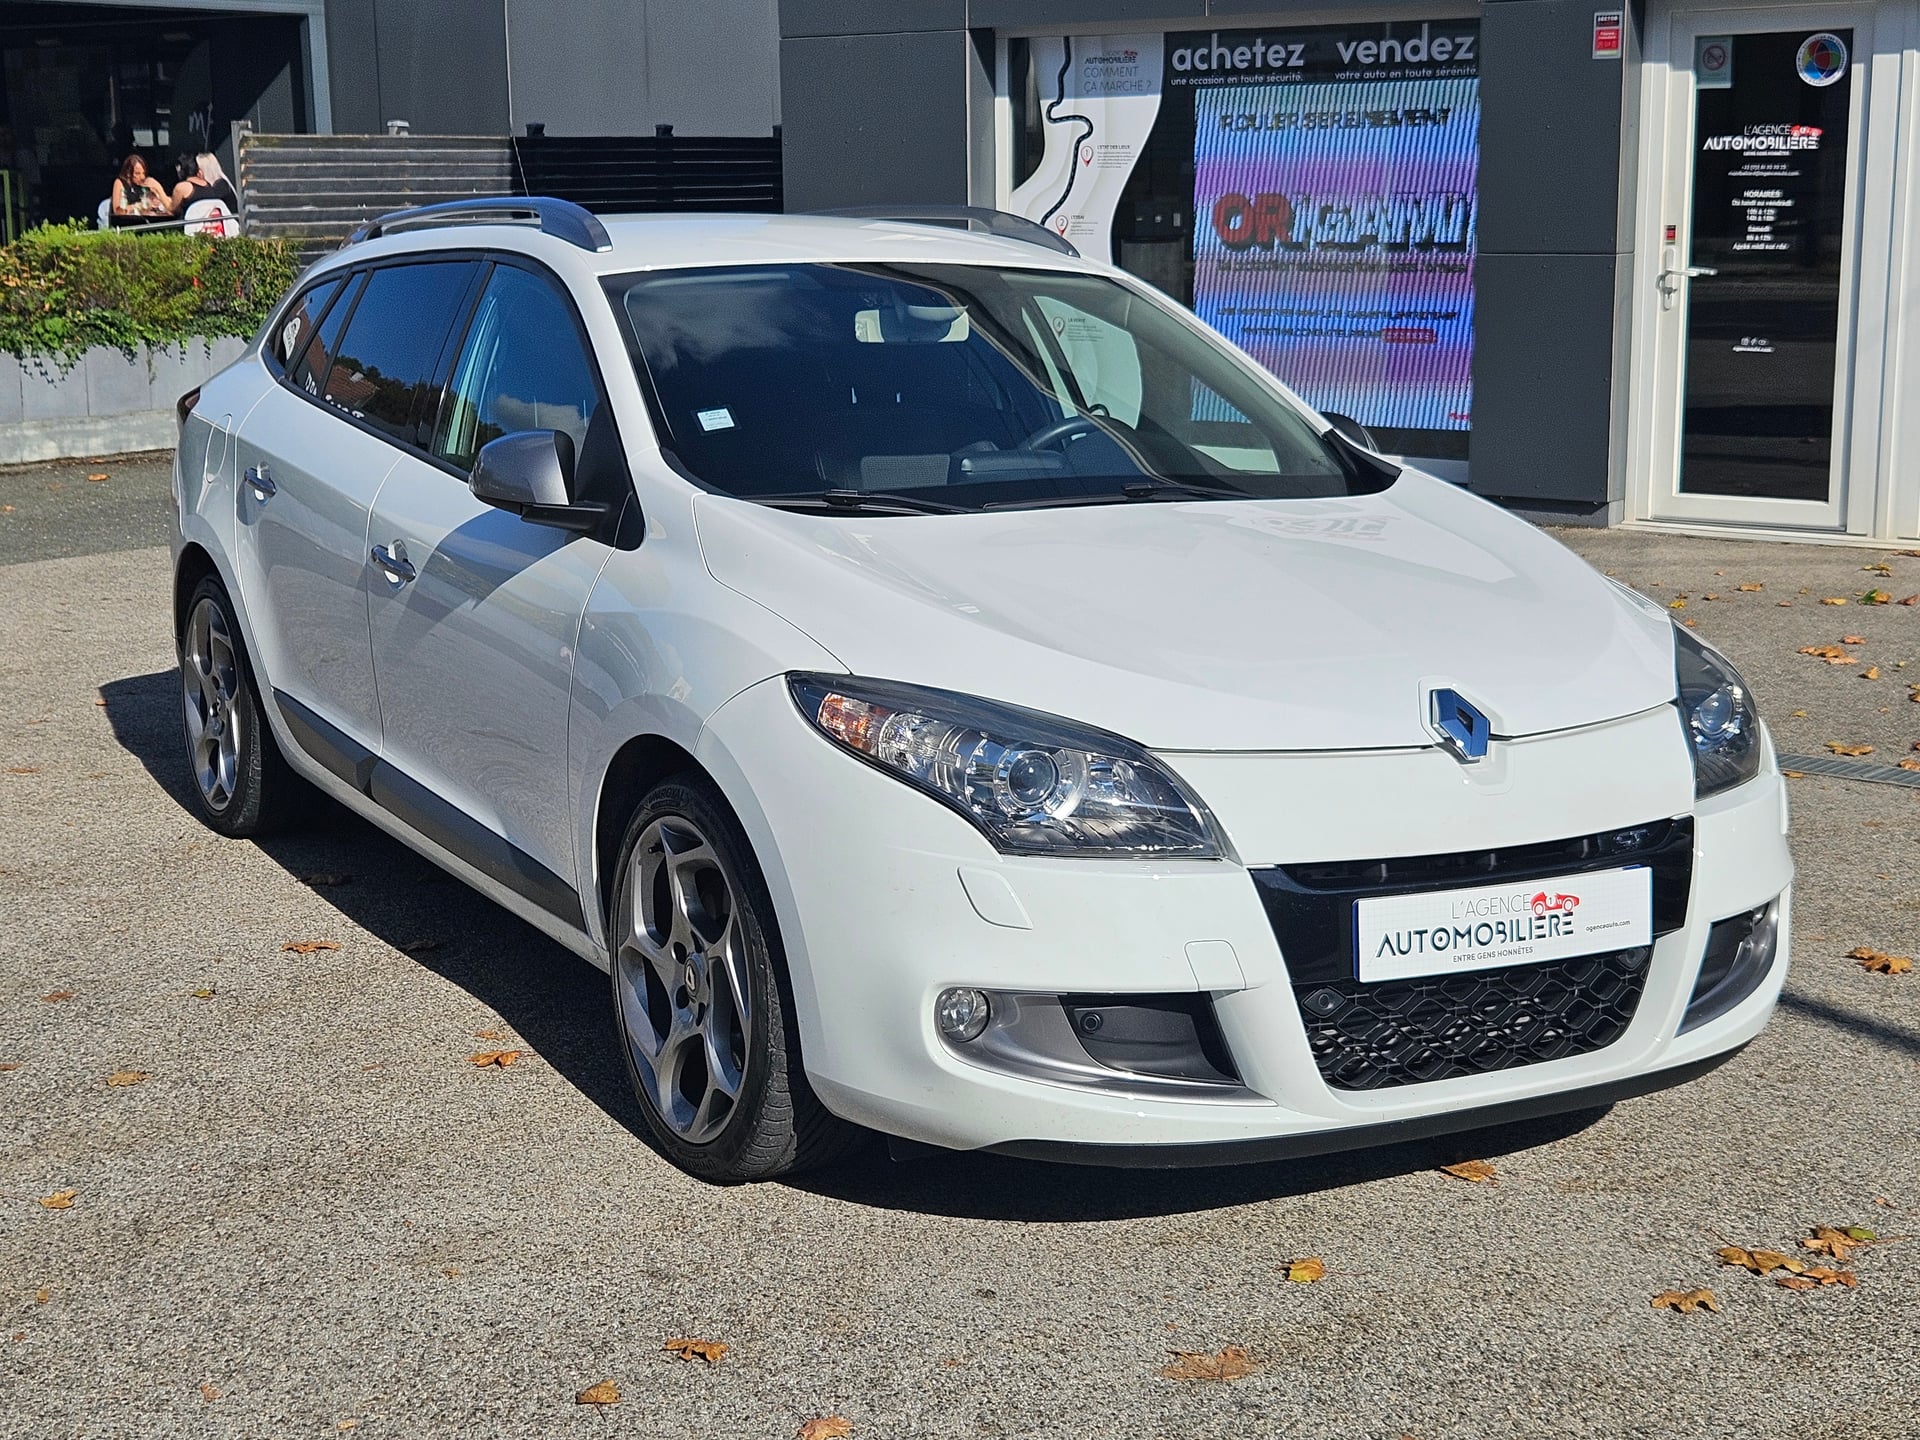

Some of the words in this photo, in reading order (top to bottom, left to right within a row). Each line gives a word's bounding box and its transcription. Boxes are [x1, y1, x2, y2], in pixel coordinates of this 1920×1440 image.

[1335, 22, 1475, 65] vendez
[1171, 32, 1305, 71] achetez
[1083, 66, 1140, 78] COMMENT
[1334, 70, 1361, 80] votre
[1363, 69, 1386, 79] auto
[1389, 69, 1401, 78] en
[1405, 67, 1432, 78] toute
[1101, 79, 1143, 92] MARCHE
[1170, 77, 1187, 86] une
[1189, 74, 1225, 85] occasion
[1227, 75, 1238, 84] en
[1240, 74, 1264, 83] toute
[1744, 124, 1791, 135] L'AGENCE
[1451, 893, 1531, 919] L'AGENCE
[1453, 953, 1476, 963] ENTRE
[1477, 951, 1496, 960] GENS
[1497, 946, 1534, 957] HONNÊTES
